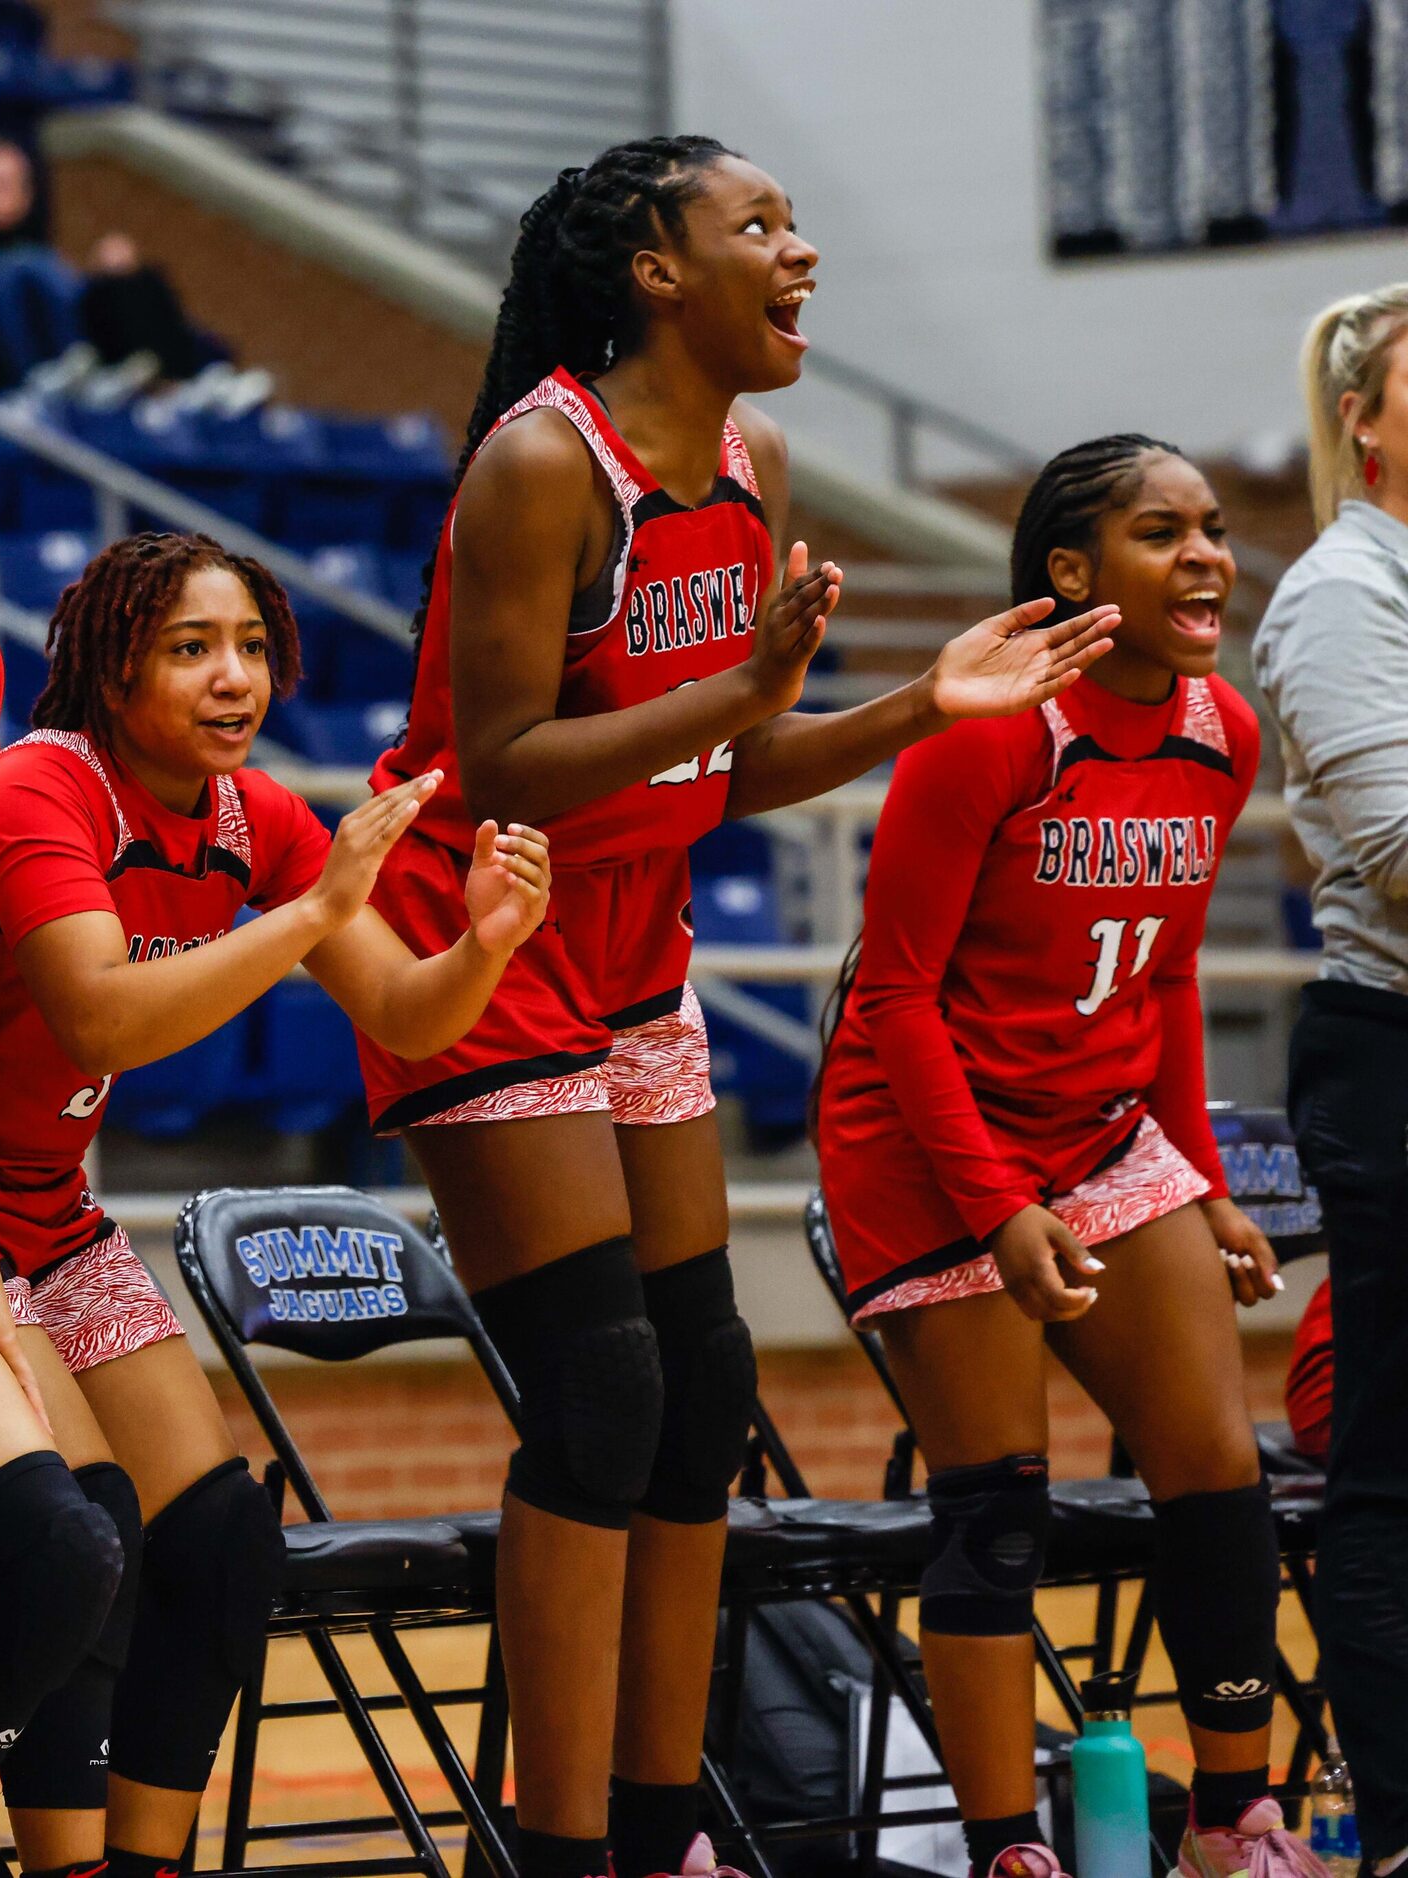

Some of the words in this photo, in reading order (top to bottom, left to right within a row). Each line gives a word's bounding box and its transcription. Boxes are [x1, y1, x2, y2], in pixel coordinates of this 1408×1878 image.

[1034, 815, 1216, 887] BRASWELL
[1074, 914, 1169, 1016] 11
[235, 1225, 404, 1288] SUMMIT
[268, 1283, 408, 1322] JAGUARS
